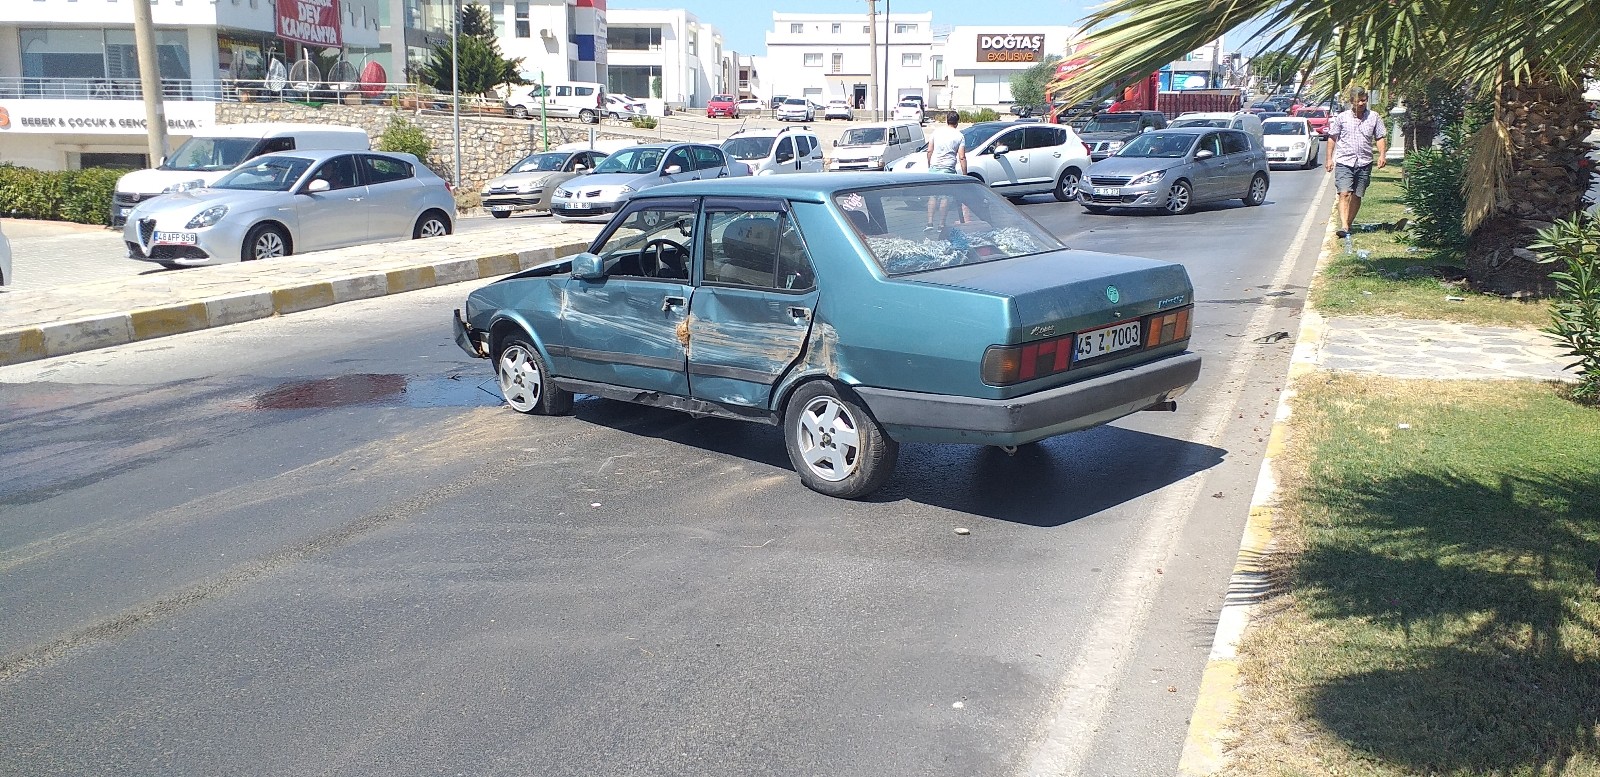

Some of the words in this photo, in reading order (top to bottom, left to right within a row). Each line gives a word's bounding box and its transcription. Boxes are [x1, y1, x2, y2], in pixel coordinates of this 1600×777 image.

[297, 1, 320, 25] DEV
[281, 15, 338, 44] KAMPANYA
[981, 33, 1042, 52] DOĞTAŞ
[987, 50, 1033, 62] exclusive
[21, 117, 56, 127] BEBEK
[58, 117, 66, 127] &
[109, 118, 116, 128] &
[168, 233, 180, 241] AFP
[181, 234, 195, 242] 958
[1078, 335, 1092, 355] 45
[1098, 333, 1105, 352] Z
[1112, 324, 1139, 347] 7003
